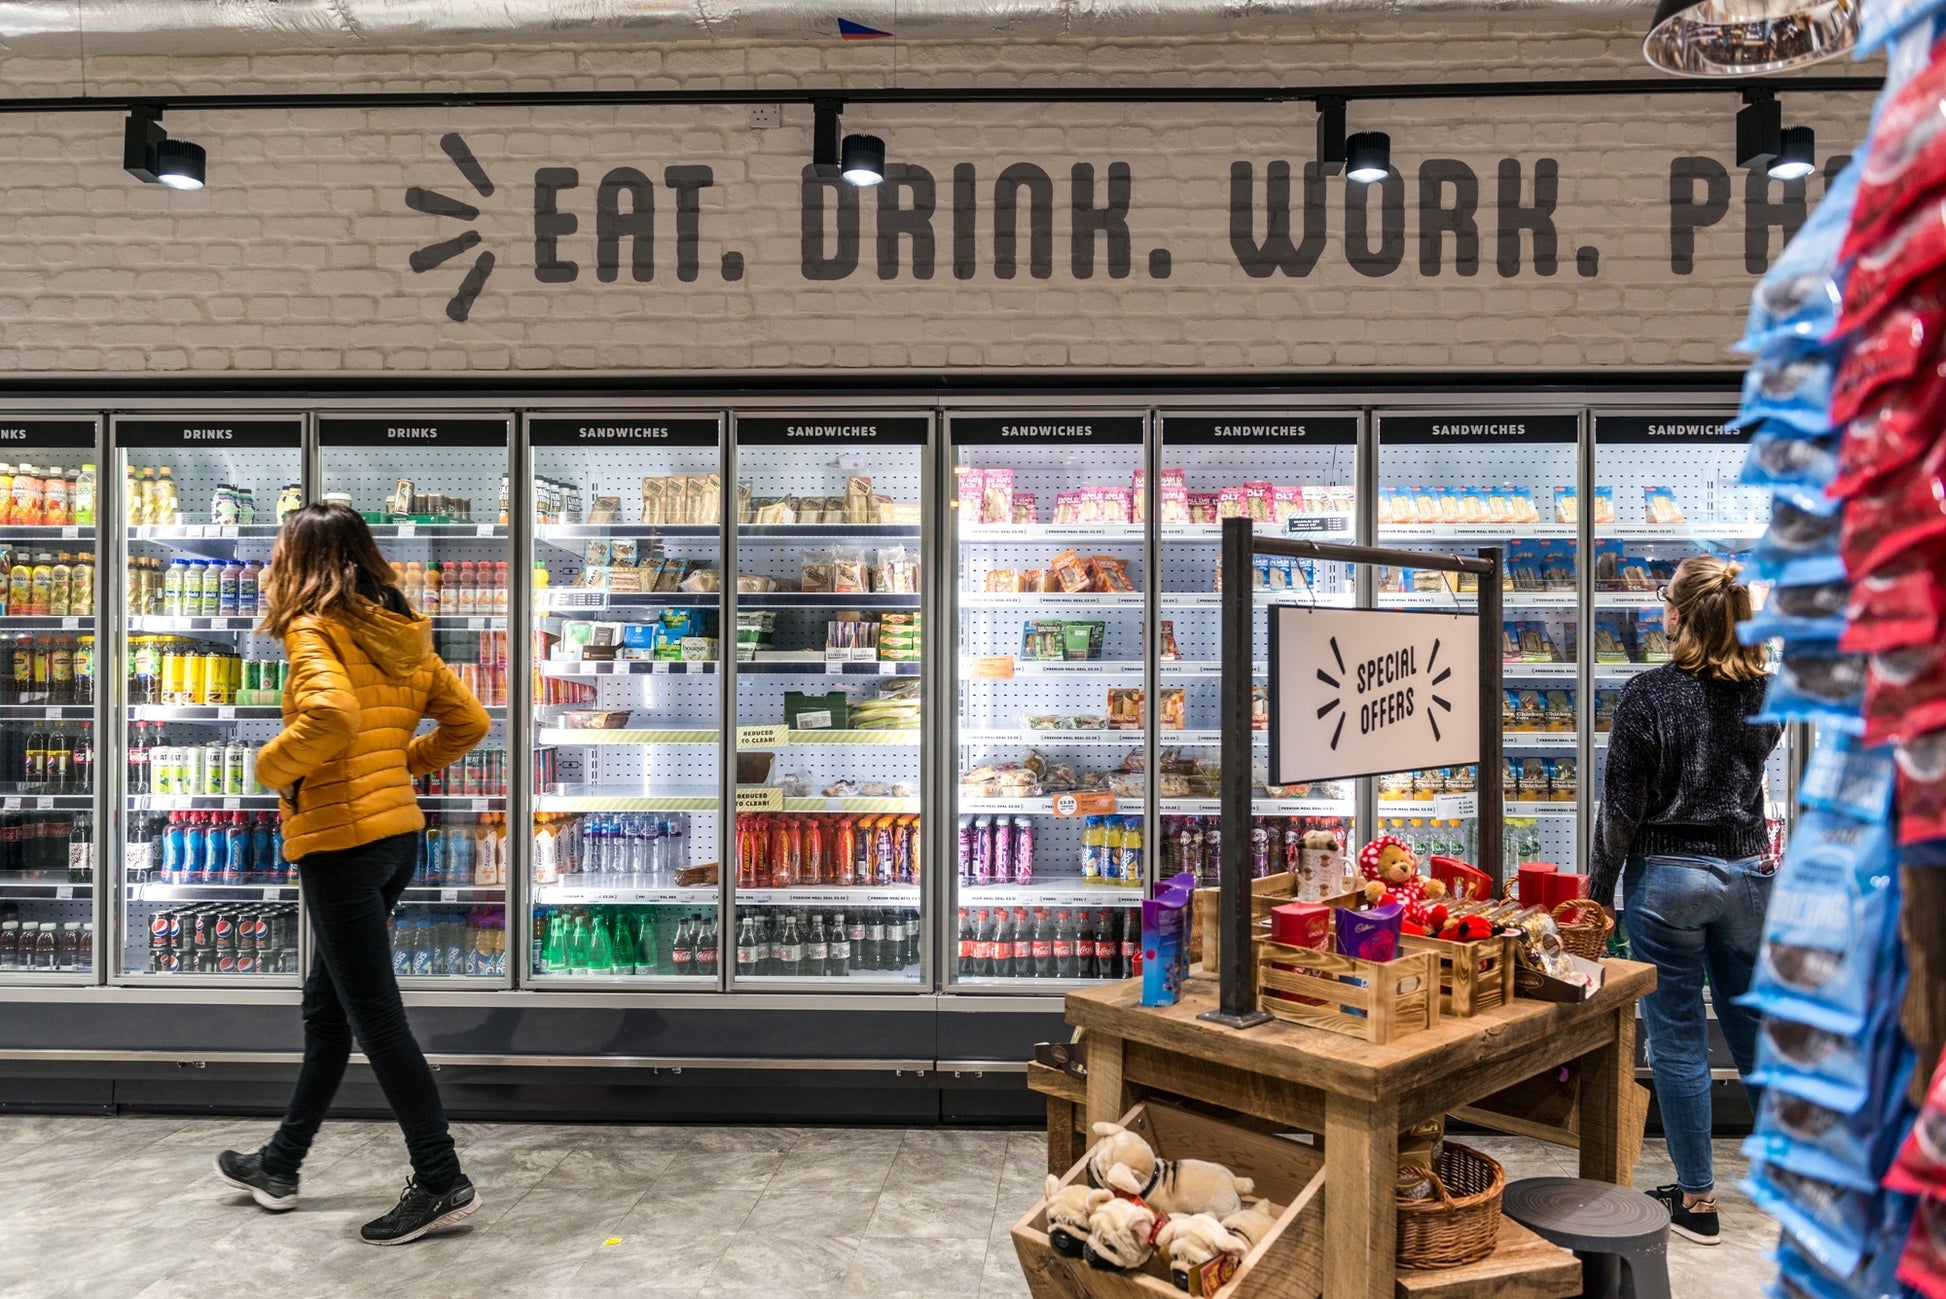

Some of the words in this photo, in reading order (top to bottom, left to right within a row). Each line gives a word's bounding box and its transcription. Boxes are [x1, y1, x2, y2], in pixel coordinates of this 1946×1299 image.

[533, 165, 745, 283] EAT.
[800, 161, 1173, 281] DRINK.
[1230, 157, 1600, 278] WORK.
[183, 429, 233, 440] DRINKS
[387, 427, 438, 438] DRINKS
[579, 427, 669, 438] SANDWICHES
[787, 426, 877, 437] SANDWICHES
[1001, 425, 1093, 437] SANDWICHES
[1214, 425, 1306, 437] SANDWICHES
[1432, 424, 1526, 436] SANDWICHES
[1648, 424, 1741, 436] SANDWICHES
[1357, 645, 1417, 695] SPECIAL
[1360, 686, 1415, 735] OFFERS
